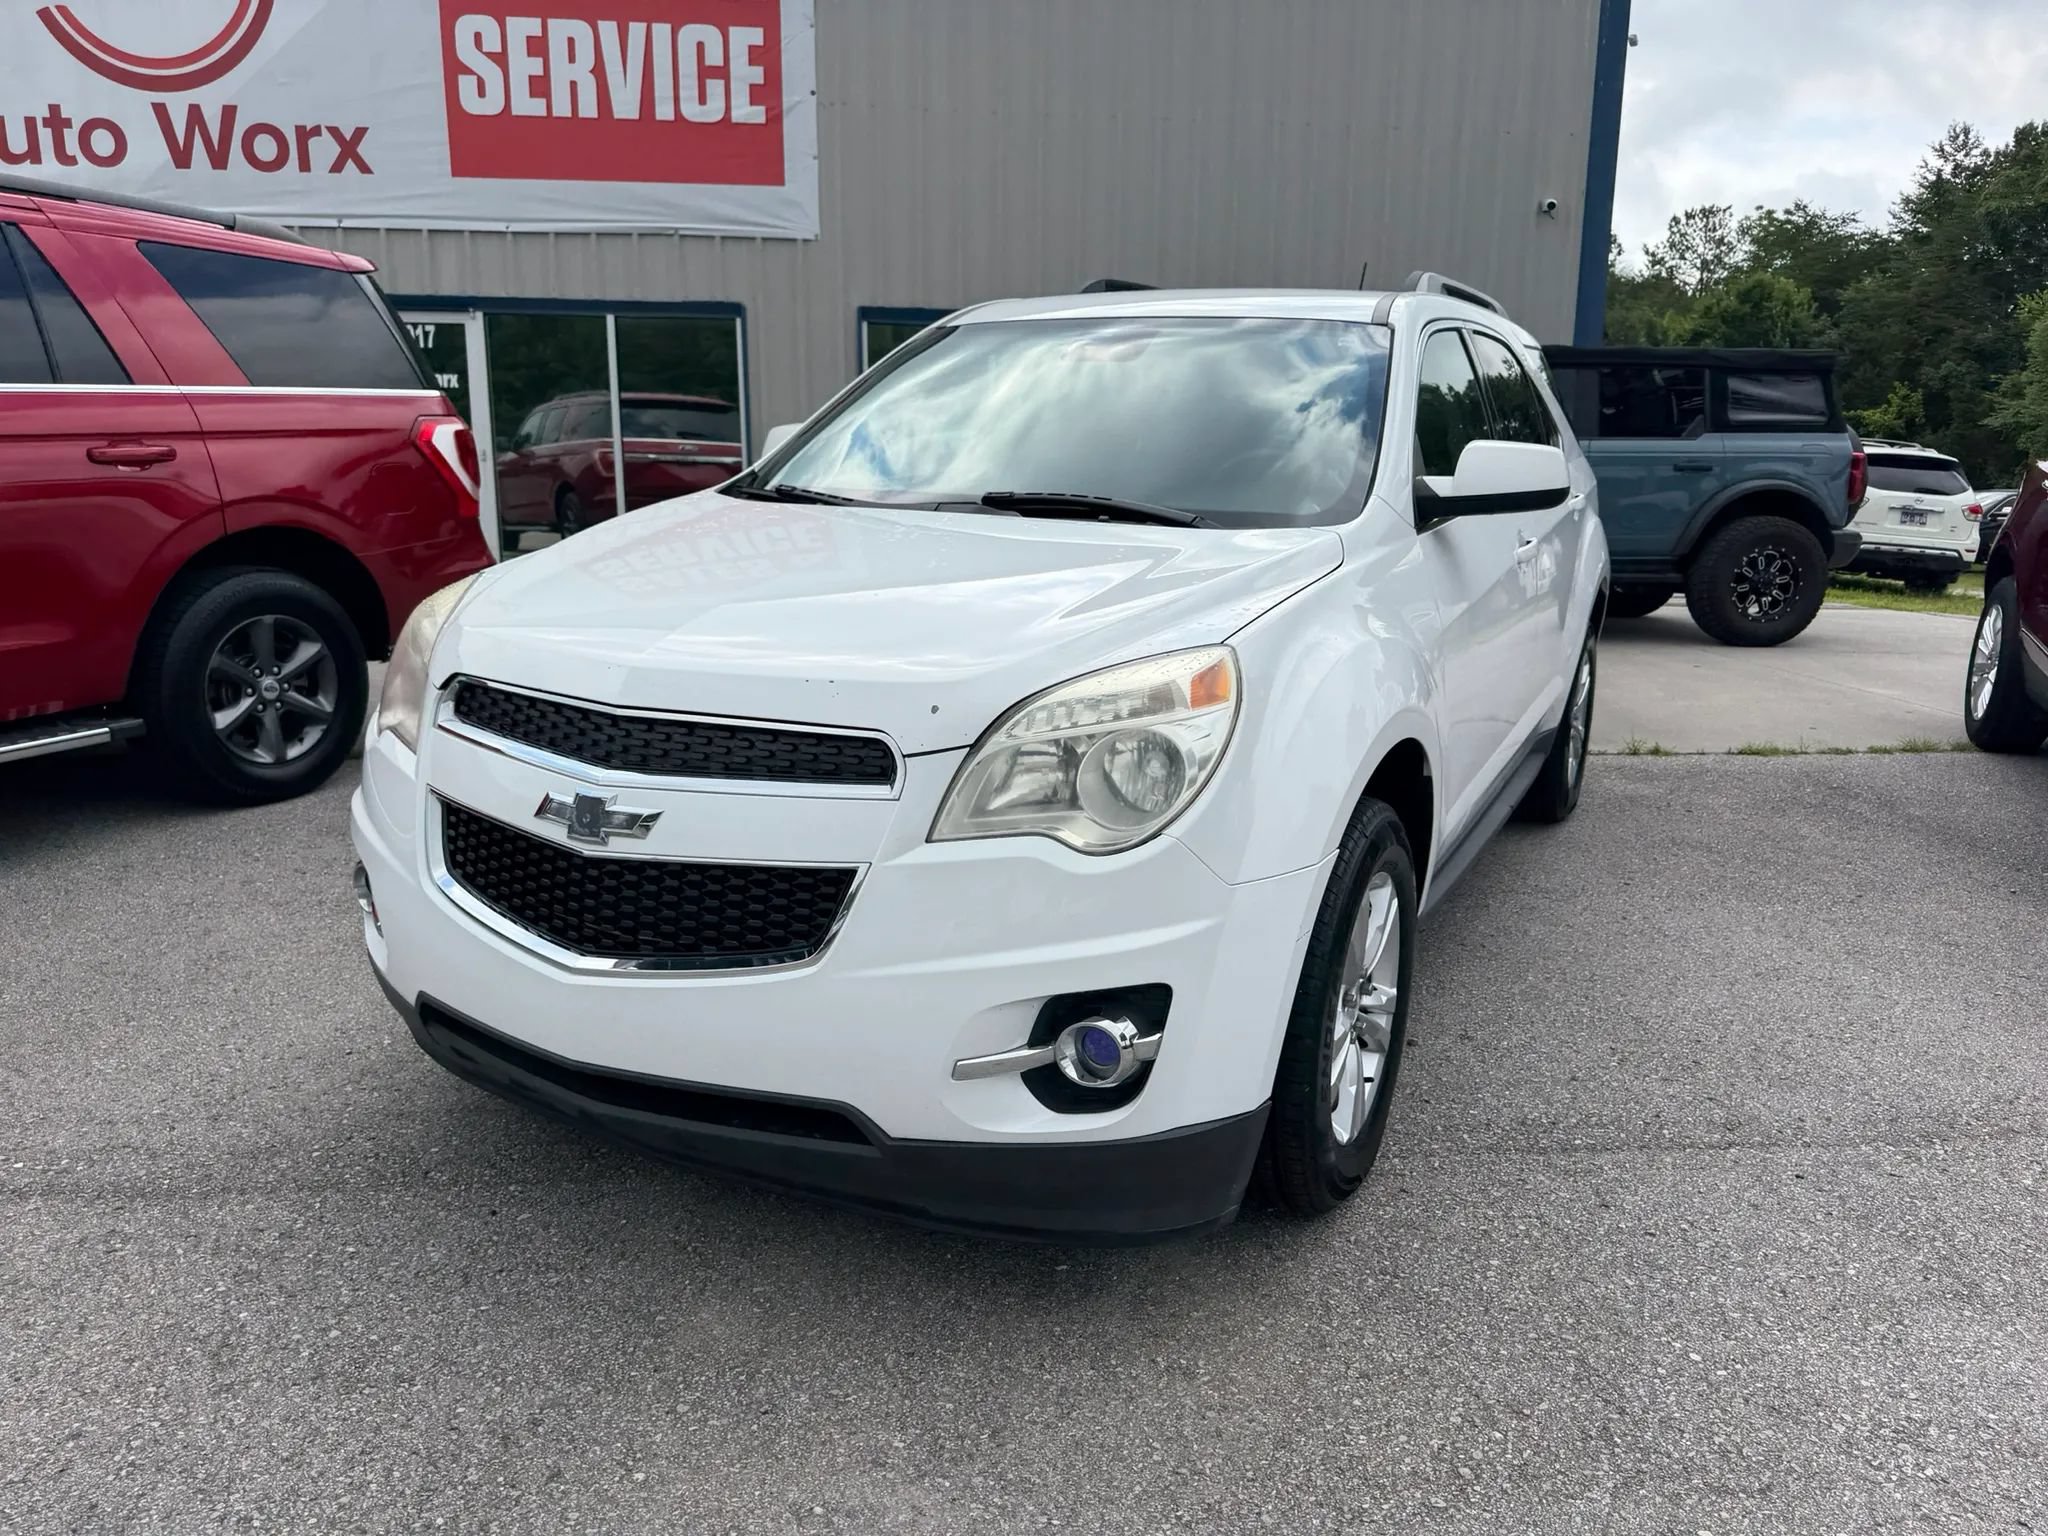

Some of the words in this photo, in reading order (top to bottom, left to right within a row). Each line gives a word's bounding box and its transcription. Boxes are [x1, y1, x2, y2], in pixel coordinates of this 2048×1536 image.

[454, 14, 767, 125] SERVICE
[0, 104, 128, 168] uto
[151, 102, 375, 175] Worx
